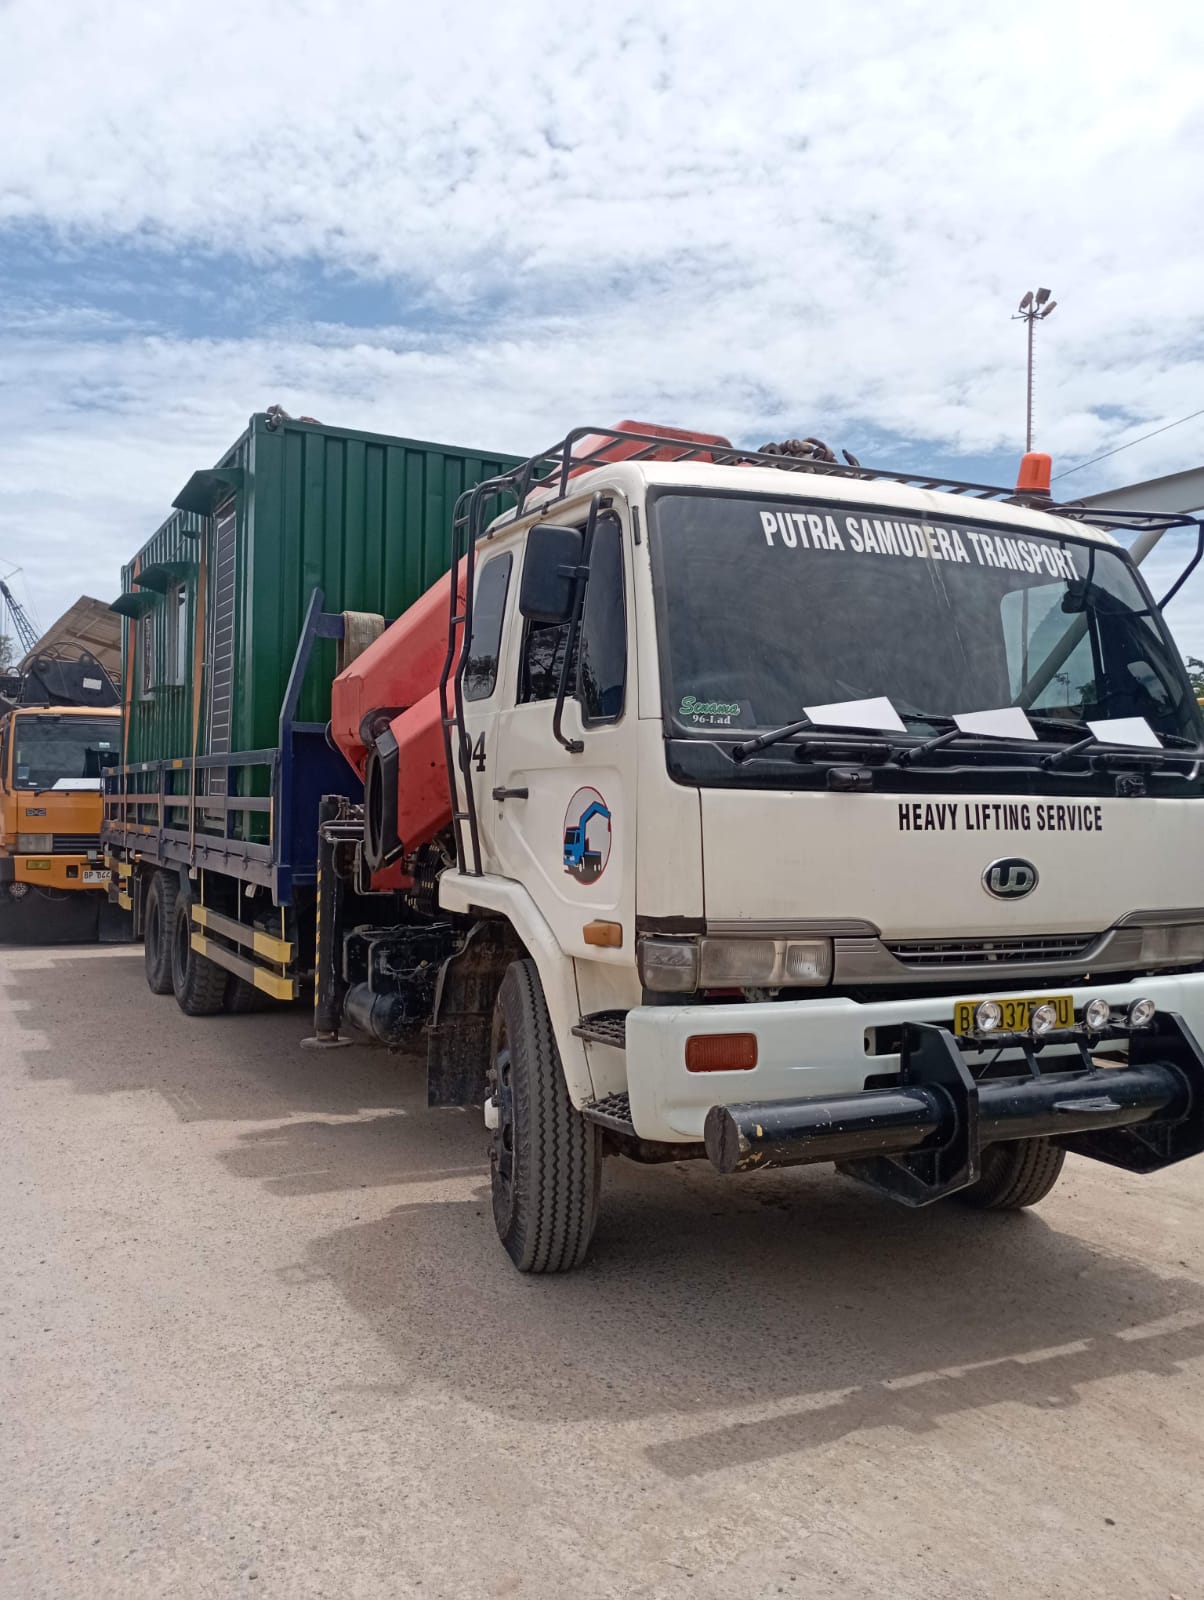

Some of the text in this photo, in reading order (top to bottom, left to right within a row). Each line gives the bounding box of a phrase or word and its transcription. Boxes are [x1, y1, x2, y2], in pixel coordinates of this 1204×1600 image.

[760, 511, 1080, 581] PUTRA SAMUDERA TRANSPORT
[899, 803, 1103, 831] HEAVY LIFTING SERVICE
[990, 866, 1034, 892] UD
